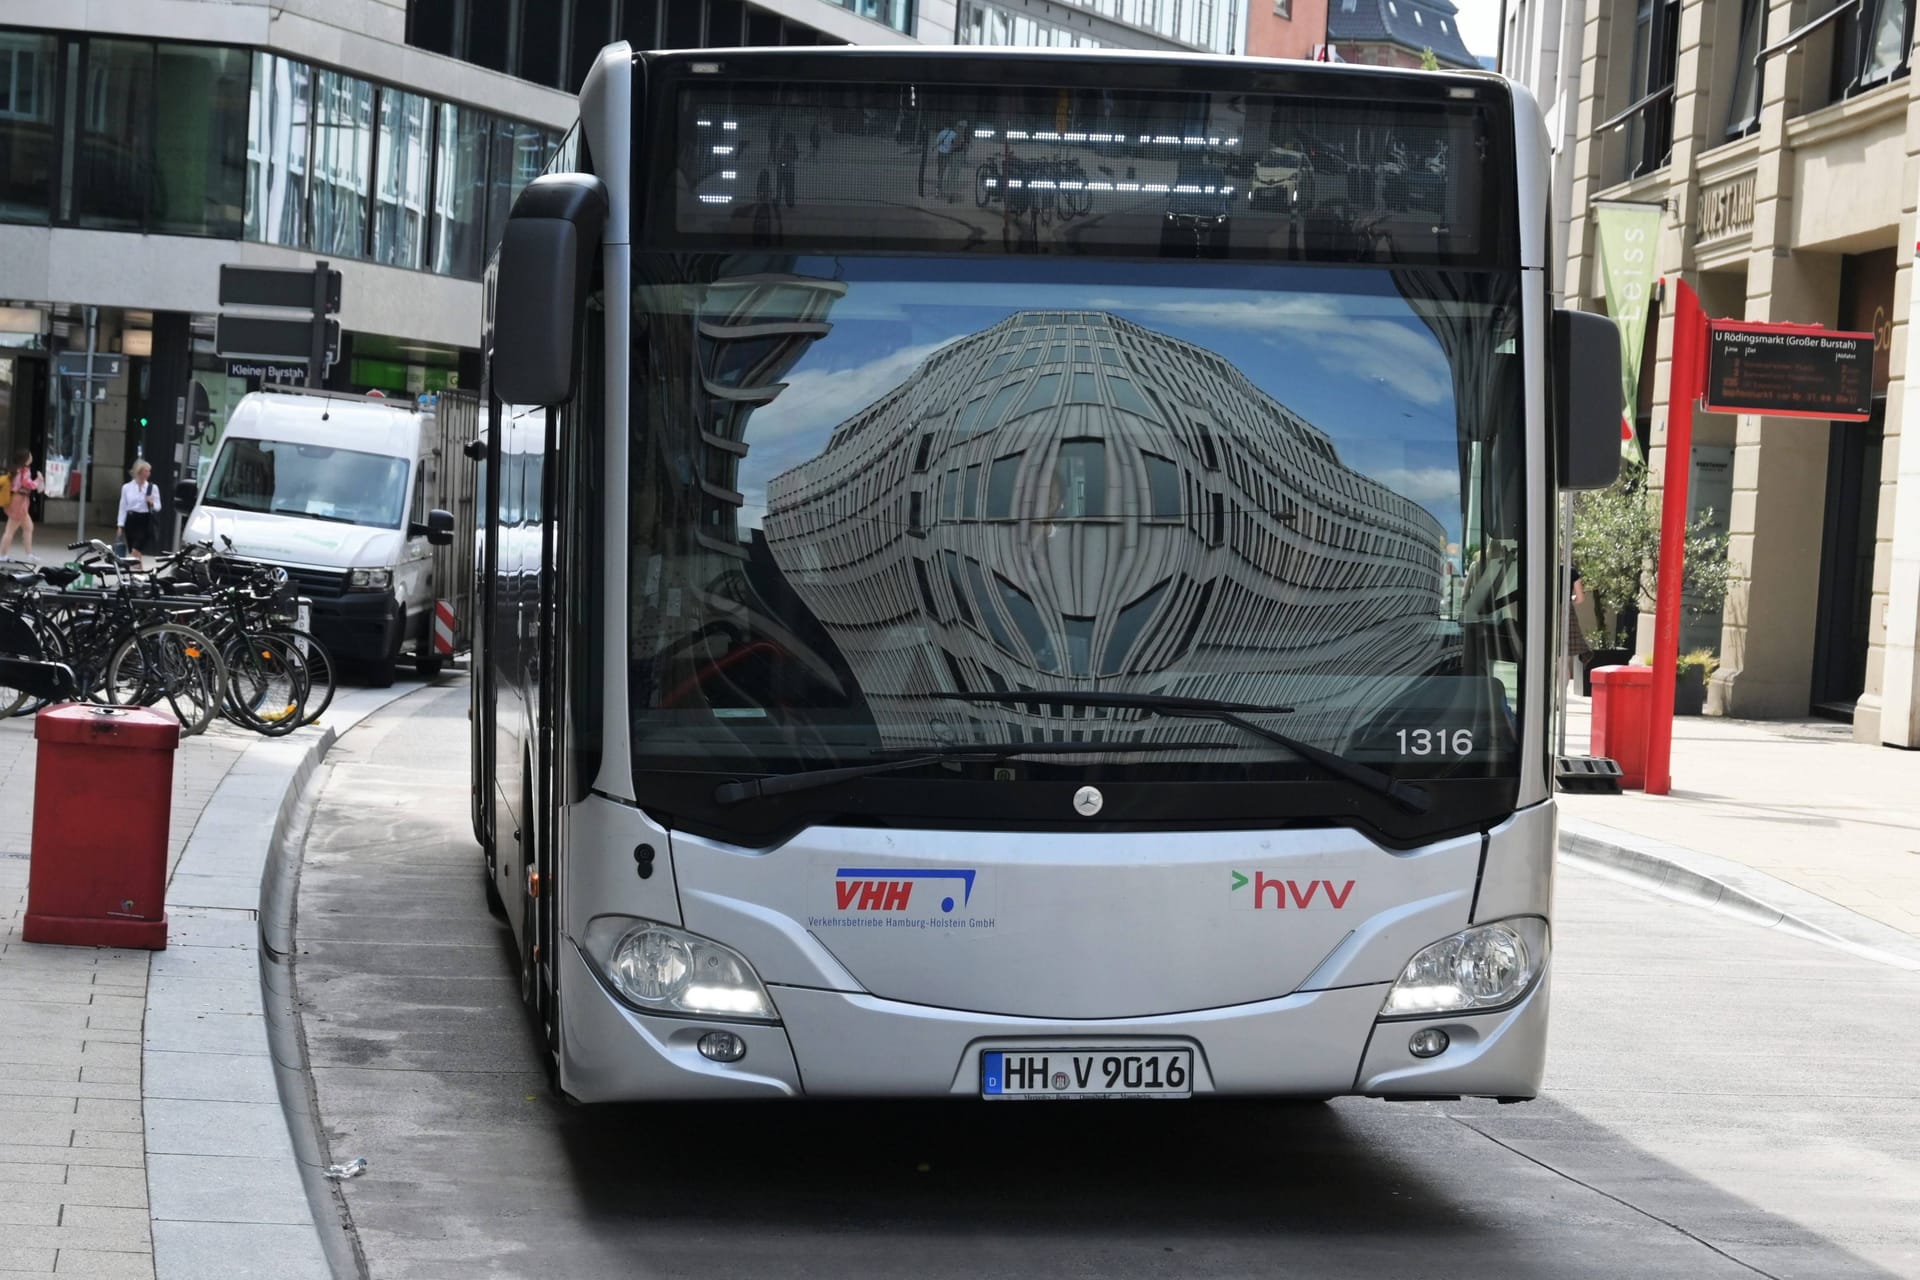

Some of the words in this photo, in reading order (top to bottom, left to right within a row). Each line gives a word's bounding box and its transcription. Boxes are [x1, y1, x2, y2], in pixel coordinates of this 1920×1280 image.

[1696, 177, 1756, 234] BURSTAHH
[1715, 332, 1722, 341] U
[1724, 332, 1785, 346] Rödingsmarkt
[1786, 337, 1818, 348] (Großer
[1821, 341, 1856, 351] Burstah)
[1396, 728, 1473, 755] 1316
[835, 881, 914, 911] VHH
[1254, 871, 1356, 909] hvv
[808, 917, 883, 927] Verkehrsbetriebe
[886, 918, 966, 929] Hamburg-Holstein
[969, 919, 995, 928] GmbH
[989, 1077, 997, 1087] D
[1005, 1057, 1049, 1089] HH
[1073, 1057, 1093, 1088] V
[1102, 1056, 1185, 1088] 9016
